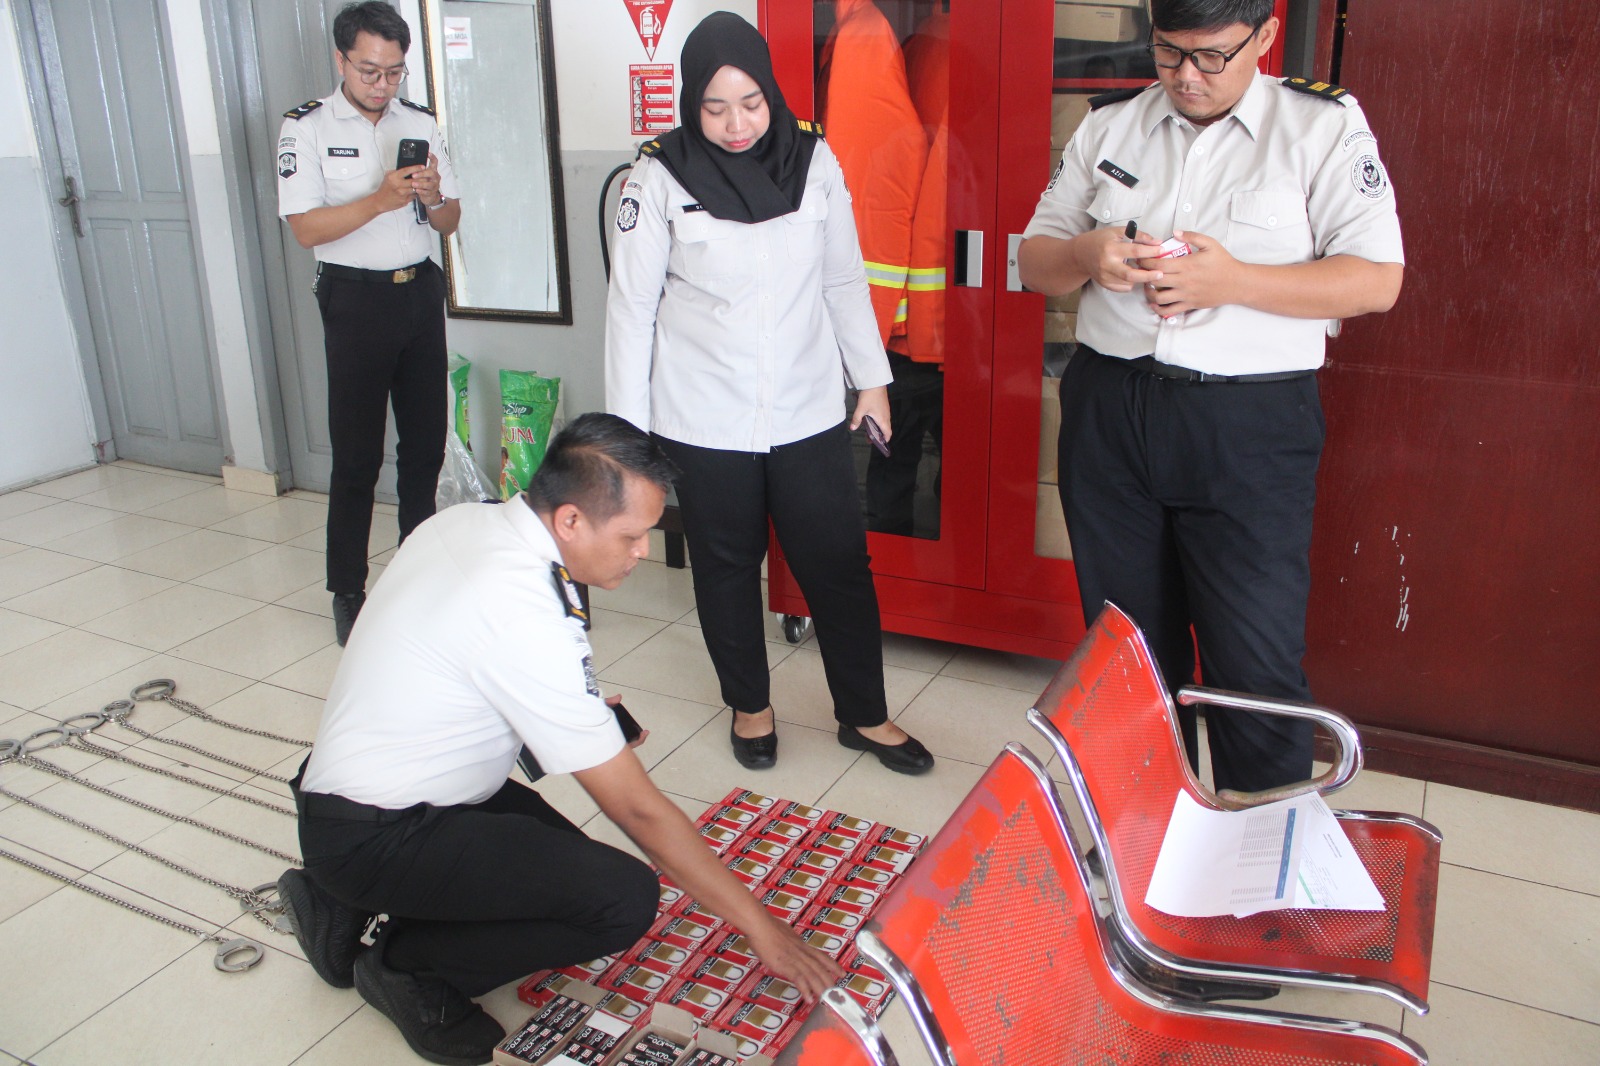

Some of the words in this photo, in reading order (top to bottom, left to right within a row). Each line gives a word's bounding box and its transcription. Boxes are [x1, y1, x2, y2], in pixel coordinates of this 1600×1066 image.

[1111, 169, 1125, 179] AZIZ
[541, 1008, 553, 1019] K70
[565, 1017, 576, 1028] K70
[581, 1027, 593, 1038] K70
[595, 1031, 606, 1042] K70
[510, 1037, 522, 1048] K70
[522, 1041, 534, 1052] K70
[652, 1038, 665, 1047] K70
[535, 1046, 547, 1057] K70
[655, 1051, 669, 1060] K70
